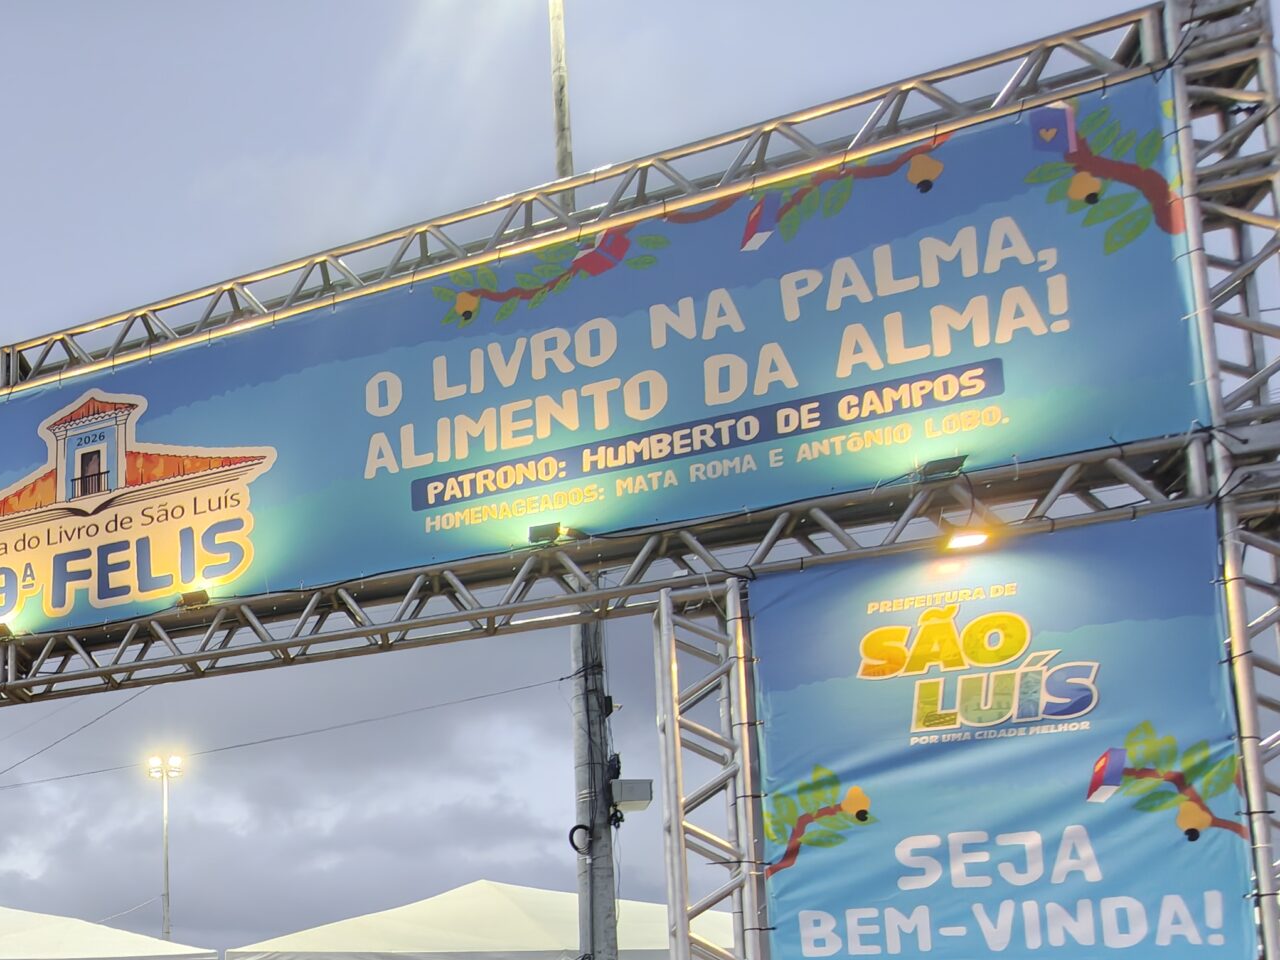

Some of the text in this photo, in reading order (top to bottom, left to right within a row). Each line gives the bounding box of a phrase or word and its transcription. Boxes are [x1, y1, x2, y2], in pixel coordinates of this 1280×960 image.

[366, 216, 1058, 417] O LIVRO NA PALMA,
[364, 272, 1070, 480] ALIMENTO DA ALMA!
[75, 431, 107, 447] 2026
[424, 482, 605, 534] HOMENAGEADOS:
[615, 469, 679, 497] MATA
[688, 453, 758, 483] ROMA
[768, 448, 784, 468] E
[925, 404, 1010, 440] LOBO.
[426, 455, 567, 504] PATRONO:
[775, 401, 821, 435] DE
[837, 367, 986, 422] CAMPOS
[13, 527, 42, 552] do
[46, 515, 100, 547] Livro
[104, 507, 134, 533] de
[140, 503, 186, 526] São
[192, 487, 242, 516] Luís
[51, 517, 245, 609] FELIS
[867, 581, 1018, 615] PREFEITURA DE
[858, 604, 1032, 680] SÃO
[909, 648, 1102, 734] LUÍS
[909, 720, 1092, 747] POR UMA CIDADE MELHOR
[894, 824, 1103, 891] SEJA
[798, 890, 1225, 958] BEM-VINDA!
